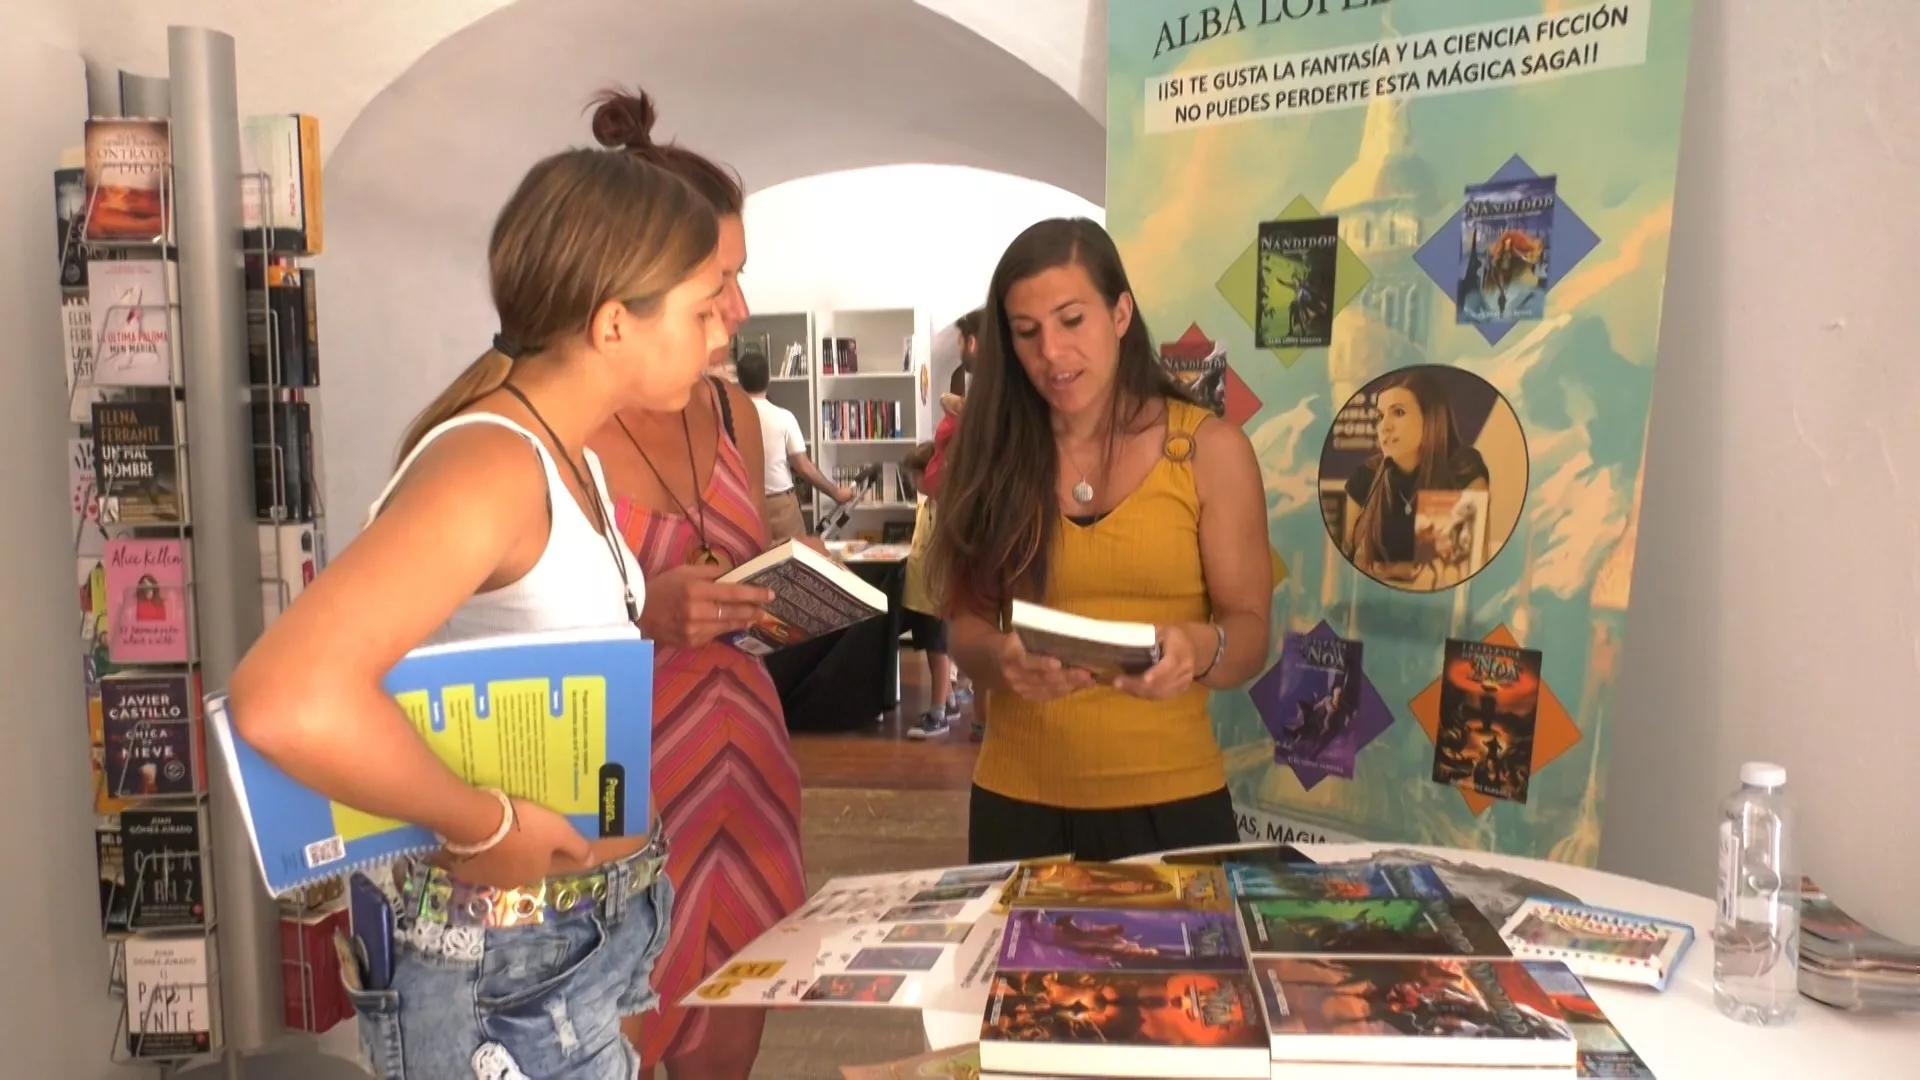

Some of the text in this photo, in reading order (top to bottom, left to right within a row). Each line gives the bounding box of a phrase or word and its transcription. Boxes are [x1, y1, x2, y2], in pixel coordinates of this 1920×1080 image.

[1153, 0, 1247, 60] ALBA
[1189, 74, 1208, 95] TE
[1213, 64, 1268, 91] GUSTA
[1273, 61, 1296, 81] LA
[1300, 43, 1391, 78] FANTASÍA
[1396, 42, 1408, 62] Y
[1413, 38, 1437, 60] LA
[1443, 24, 1531, 54] CIENCIA
[1536, 4, 1629, 43] FICCIÓN
[1175, 105, 1201, 124] NO
[1206, 92, 1270, 120] PUEDES
[1275, 78, 1370, 110] PERDERTE
[1375, 71, 1420, 96] ESTA
[1426, 58, 1516, 89] MÁGICA
[109, 705, 181, 720] CASTILLO
[119, 694, 170, 707] JAVIER
